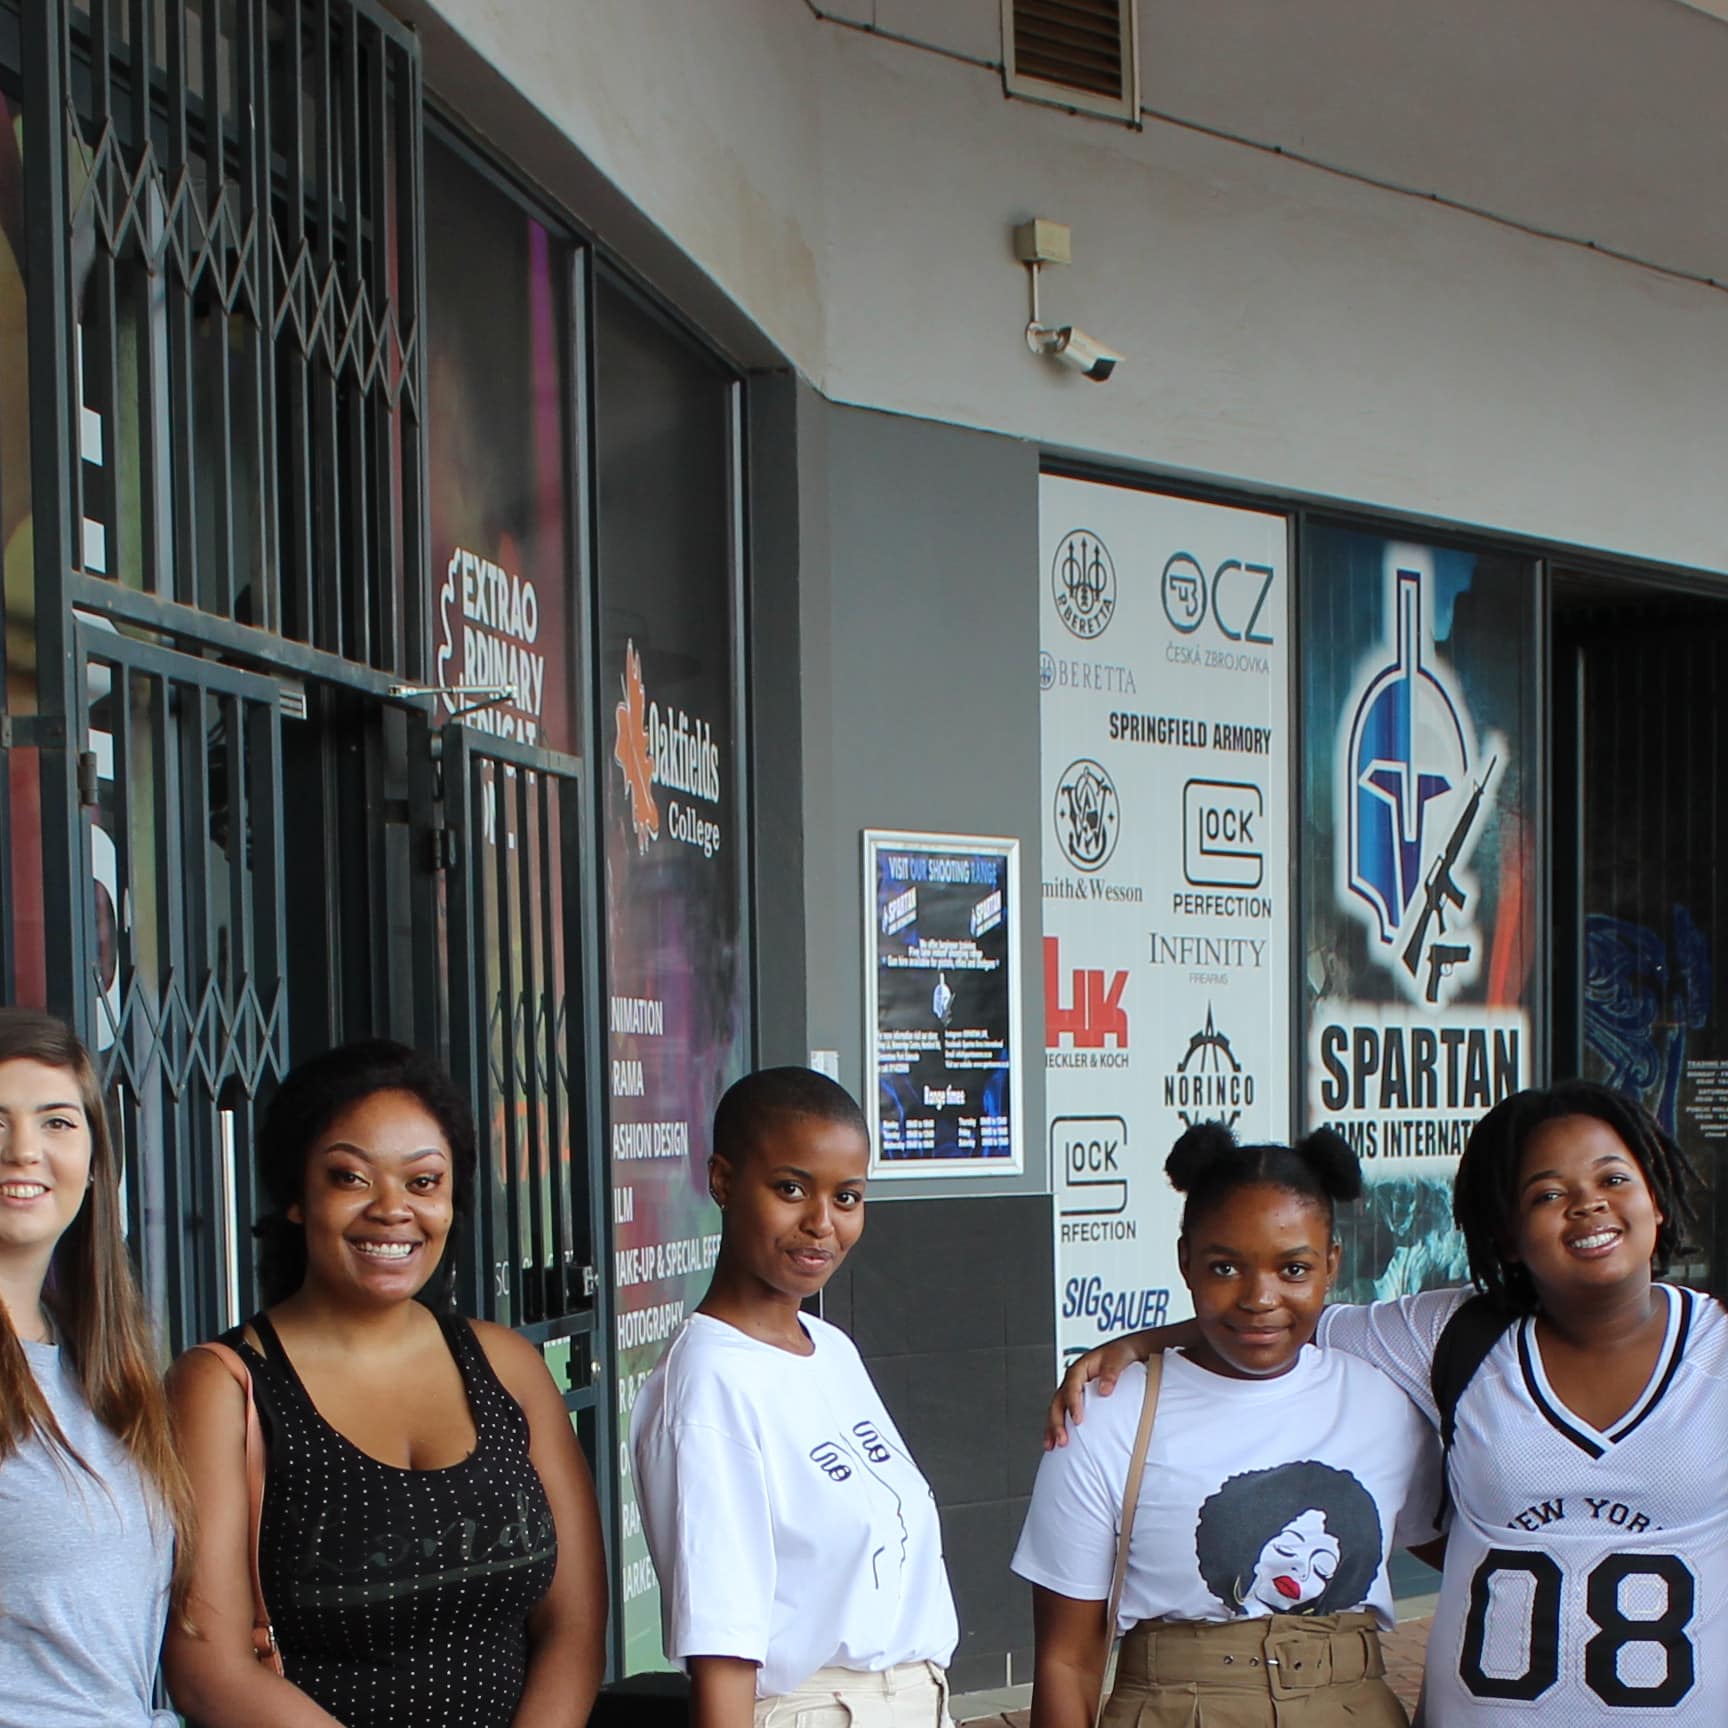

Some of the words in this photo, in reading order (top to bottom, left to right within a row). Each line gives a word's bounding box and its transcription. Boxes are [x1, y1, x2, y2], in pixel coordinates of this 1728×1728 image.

[461, 549, 538, 644] EXTRAO
[1211, 558, 1274, 647] CZ
[1062, 598, 1113, 635] BERETTA
[1058, 660, 1137, 695] BERETTA
[1204, 648, 1270, 677] ZBROJOVKA
[648, 701, 719, 803] Oakfields
[1108, 711, 1208, 750] SPRINGFIELD
[1212, 720, 1272, 756] ARMORY
[667, 801, 721, 859] College
[888, 857, 909, 881] VISIT
[928, 859, 970, 884] SHOOTING
[1172, 893, 1272, 920] PERFECTION
[1147, 932, 1266, 969] INFINITY
[1100, 1051, 1129, 1069] KOCH
[1320, 1024, 1520, 1112] SPARTAN
[1163, 1075, 1255, 1107] NORINCO
[653, 1120, 688, 1159] DESIGN
[665, 1238, 702, 1278] SPECIAL
[1062, 1275, 1102, 1318] SIG
[1097, 1288, 1170, 1332] SAUER
[1507, 1497, 1565, 1531] EW
[1583, 1497, 1664, 1533] YOR
[1458, 1547, 1696, 1709] 08
